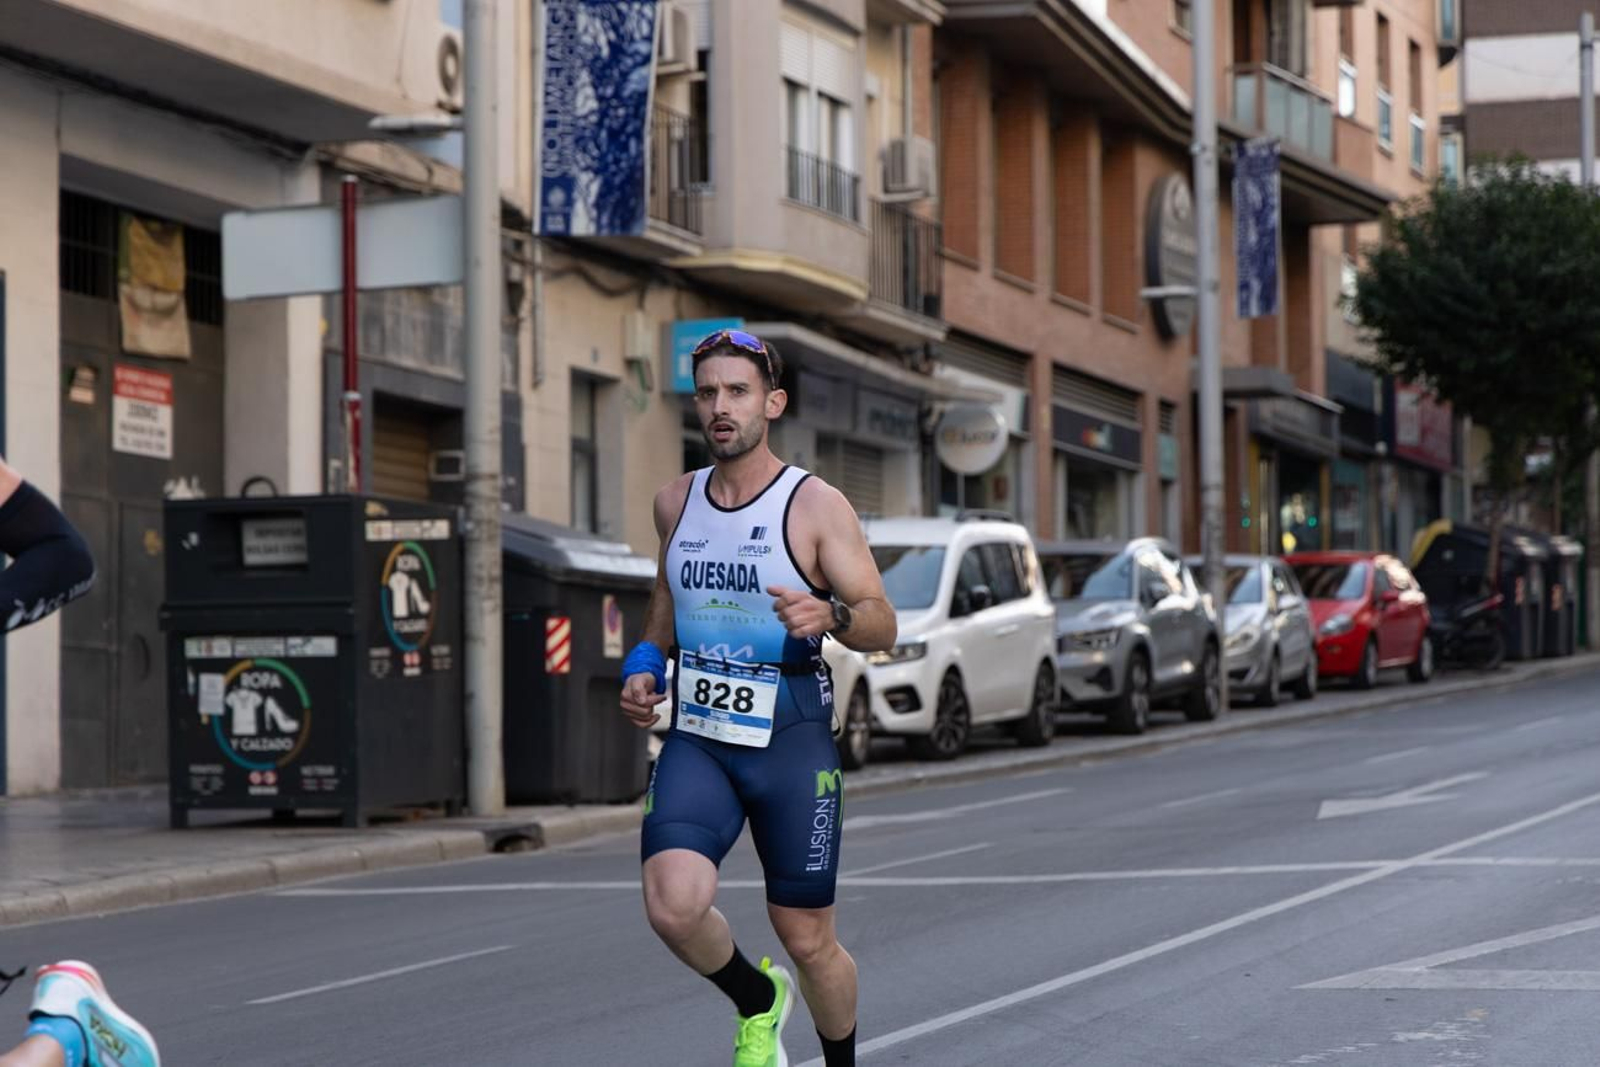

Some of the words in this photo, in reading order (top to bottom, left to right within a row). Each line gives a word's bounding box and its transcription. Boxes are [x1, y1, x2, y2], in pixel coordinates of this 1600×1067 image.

[681, 560, 760, 593] QUESADA
[240, 671, 282, 688] ROPA
[694, 678, 754, 713] 828
[241, 737, 294, 751] CALZADO
